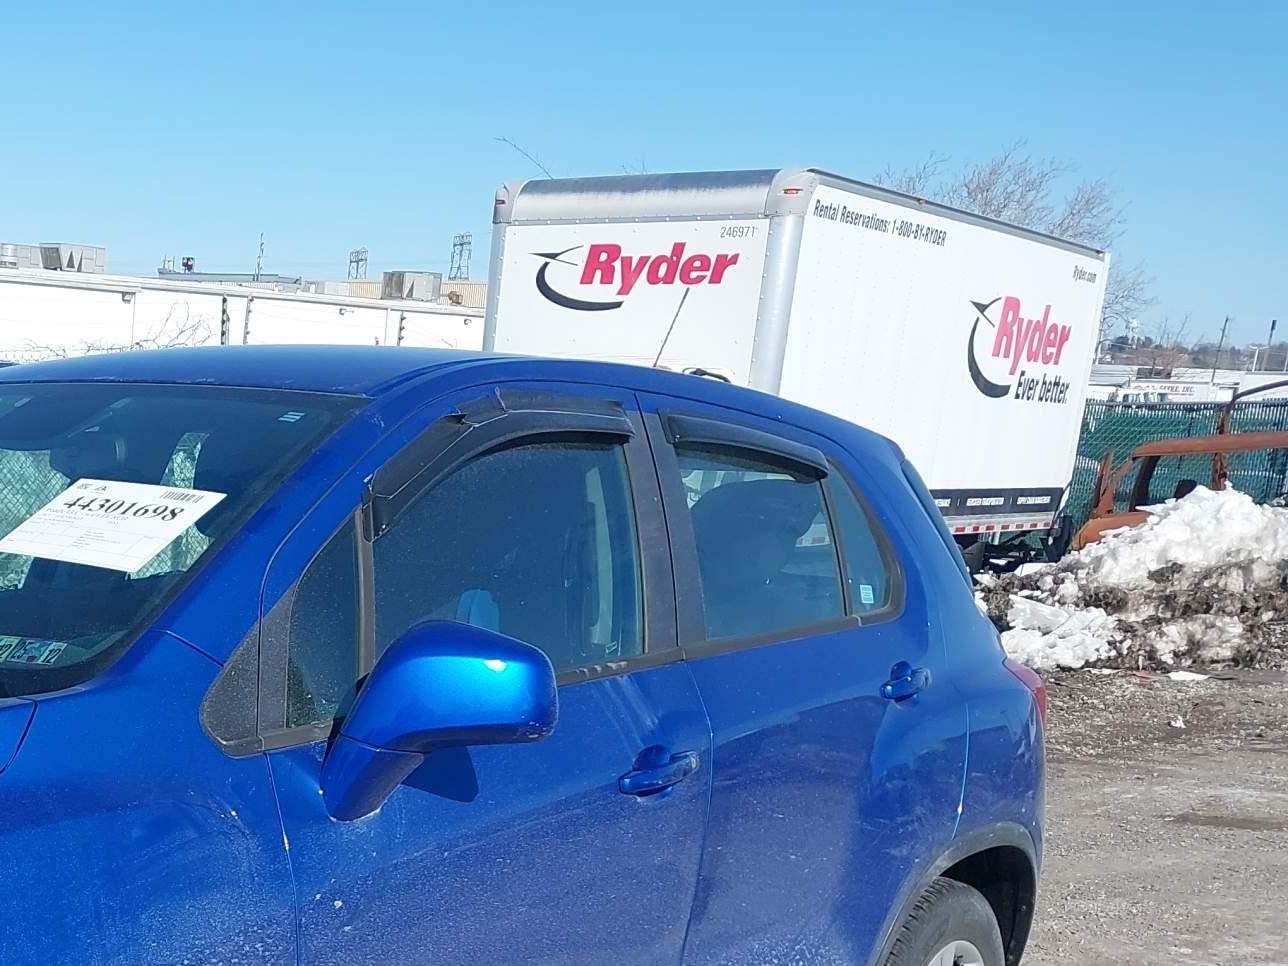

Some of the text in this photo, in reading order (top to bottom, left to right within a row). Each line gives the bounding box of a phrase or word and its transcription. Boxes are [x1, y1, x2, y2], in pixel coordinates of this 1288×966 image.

[720, 226, 756, 238] 246971
[813, 199, 947, 247] Rental Reservations: 1-800-BY-RYDER
[579, 242, 740, 295] Ryder
[992, 296, 1072, 375] Ryder
[1014, 370, 1070, 404] Ever better.
[64, 495, 185, 521] 44301698
[13, 639, 61, 663] 25 12
